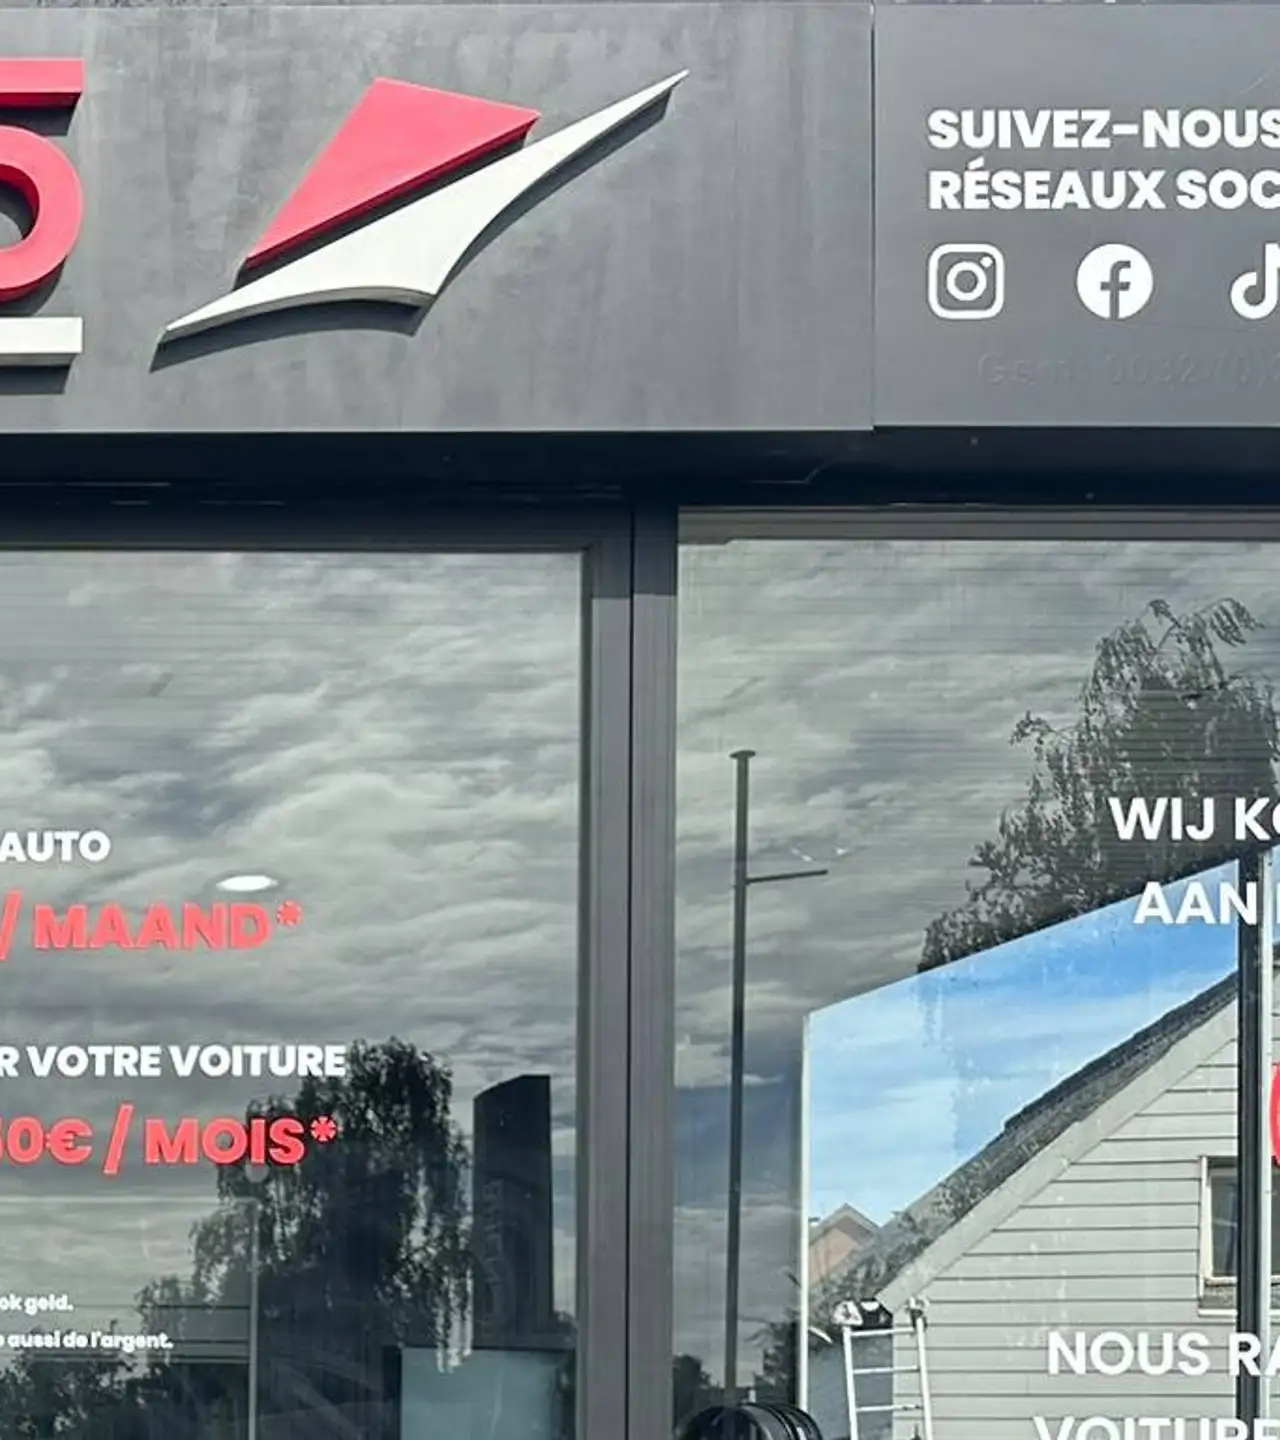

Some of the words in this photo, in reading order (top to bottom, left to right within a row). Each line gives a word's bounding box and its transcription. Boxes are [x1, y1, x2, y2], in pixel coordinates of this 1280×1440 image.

[928, 109, 1280, 148] SUIVEZ-NOUS
[928, 156, 1167, 209] RÉSEAUX
[1176, 169, 1280, 209] SOC
[1109, 797, 1214, 841] WIJ
[1234, 797, 1280, 841] K
[1133, 879, 1258, 925] AAN
[26, 1045, 162, 1078] VOTRE
[169, 1045, 347, 1078] VOITURE
[24, 1293, 75, 1316] geld.
[7, 1329, 61, 1349] aussi
[62, 1331, 89, 1349] de
[1048, 1331, 1212, 1376] NOUS
